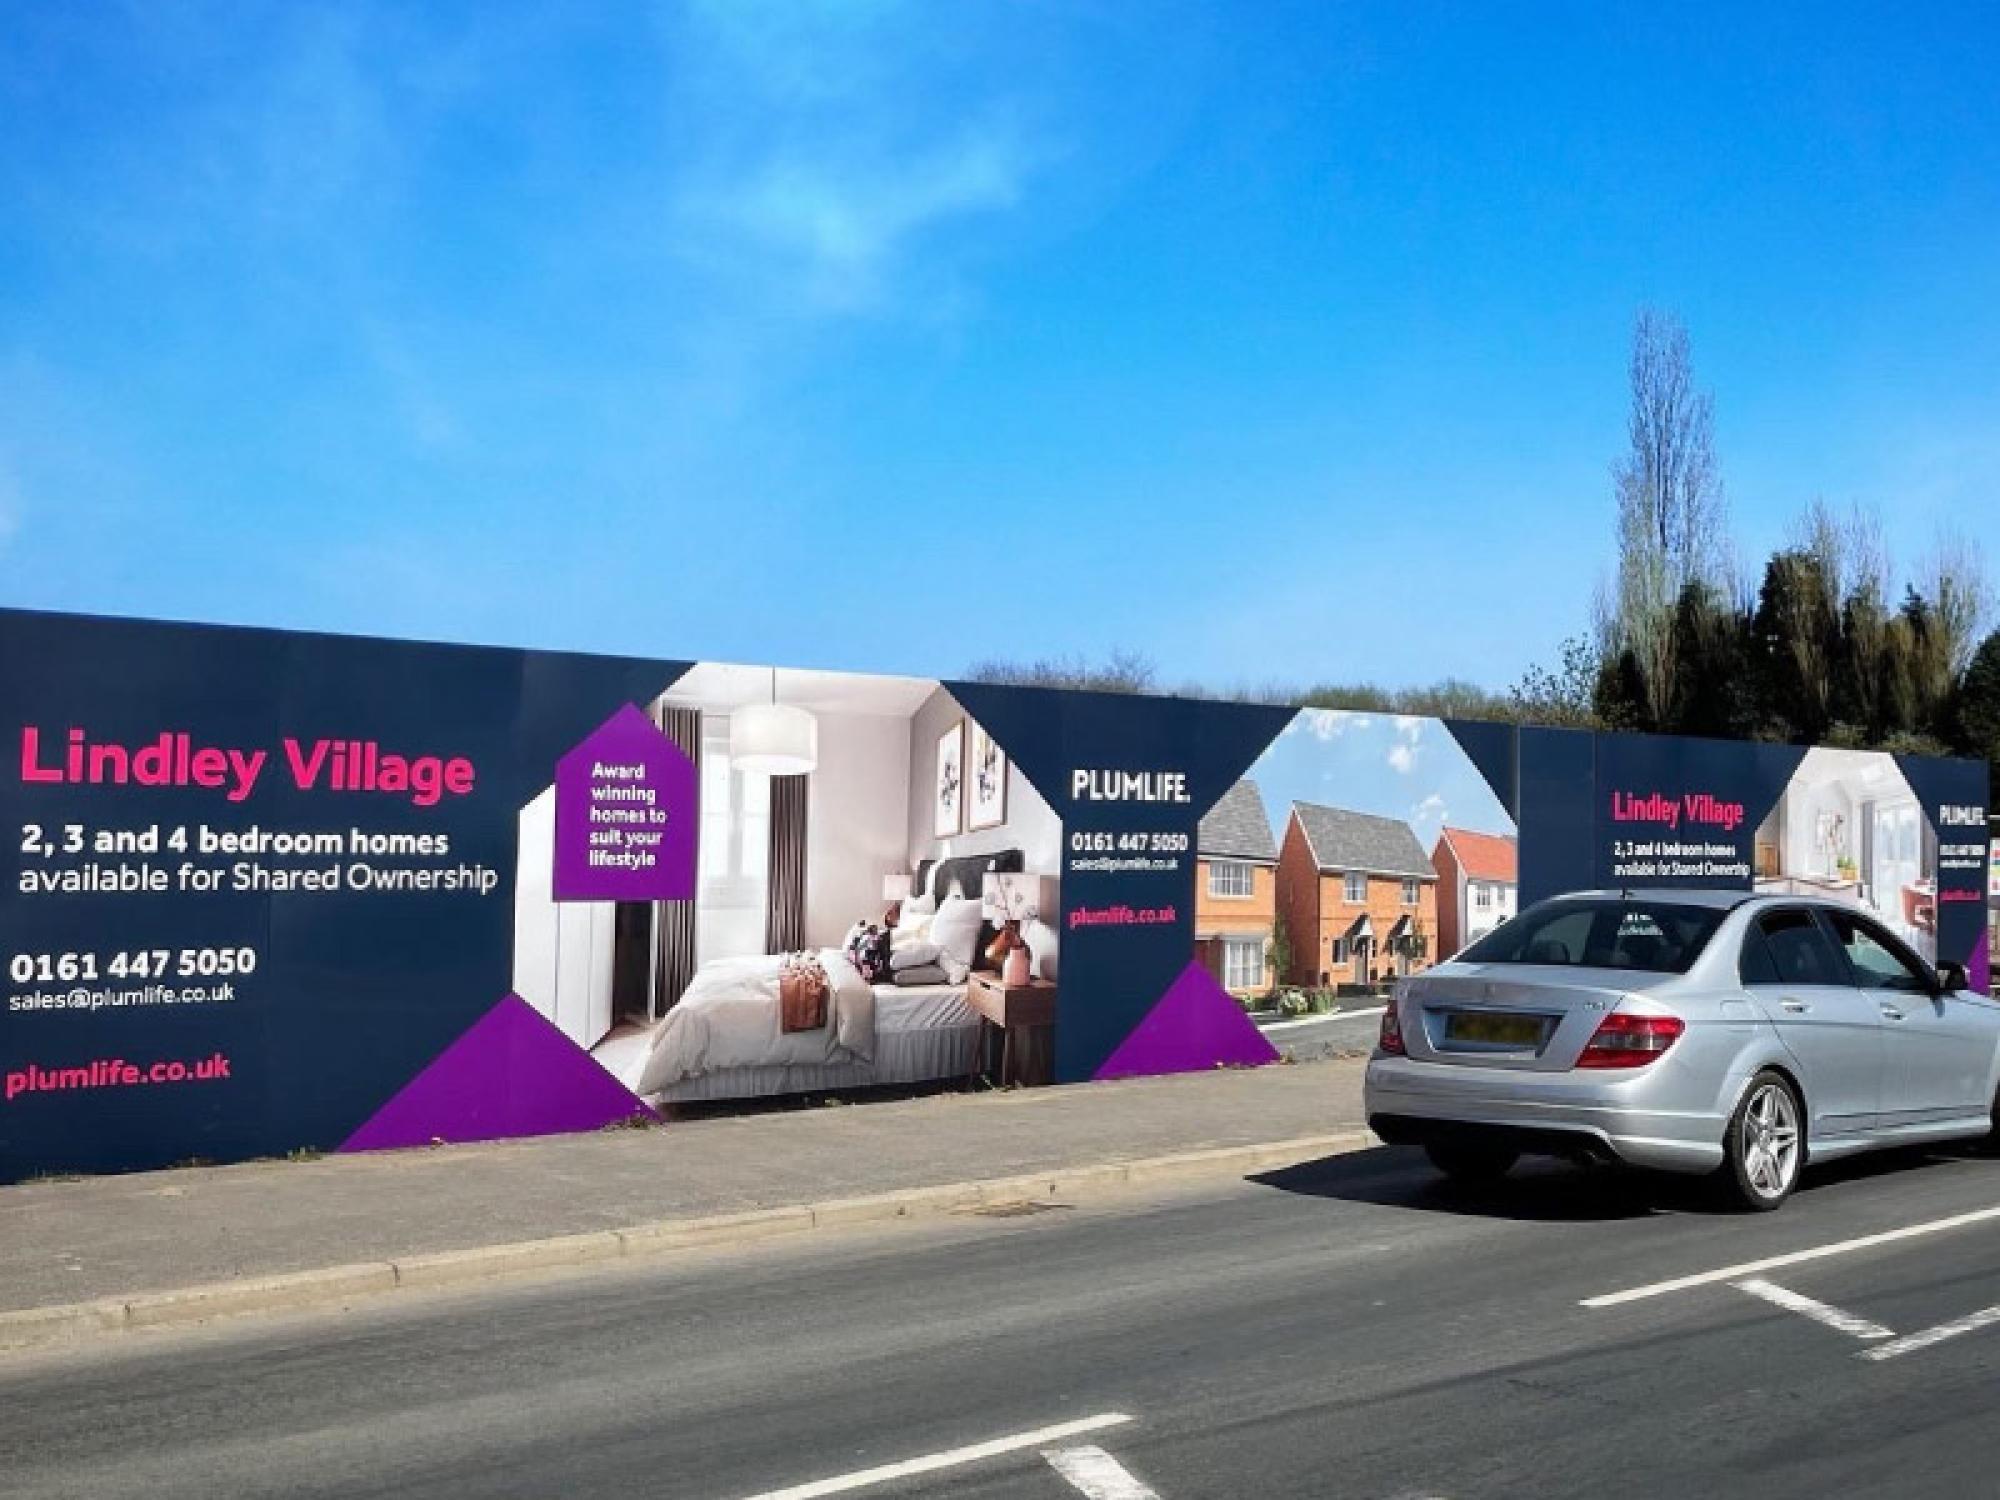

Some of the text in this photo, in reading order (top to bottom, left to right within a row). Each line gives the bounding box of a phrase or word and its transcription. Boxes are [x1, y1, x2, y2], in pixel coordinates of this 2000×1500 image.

[20, 726, 475, 806] Lindley Village
[592, 762, 645, 780] Award
[590, 785, 655, 805] winning
[590, 804, 667, 824] homes to
[1613, 791, 1744, 830] Lindley Village
[20, 824, 449, 858] 2, 3 and 4 bedroom homes
[590, 828, 663, 848] suit your
[1071, 832, 1189, 852] 0161 447 5050
[589, 849, 655, 870] lifestyle
[19, 862, 498, 895] available for Shared Ownership
[1069, 904, 1176, 930] plumlife.co.uk
[10, 947, 256, 983] 0161 447 5050
[9, 982, 236, 1011] sales@plumlife.co.uk
[5, 1052, 231, 1099] plumlife.co.uk
